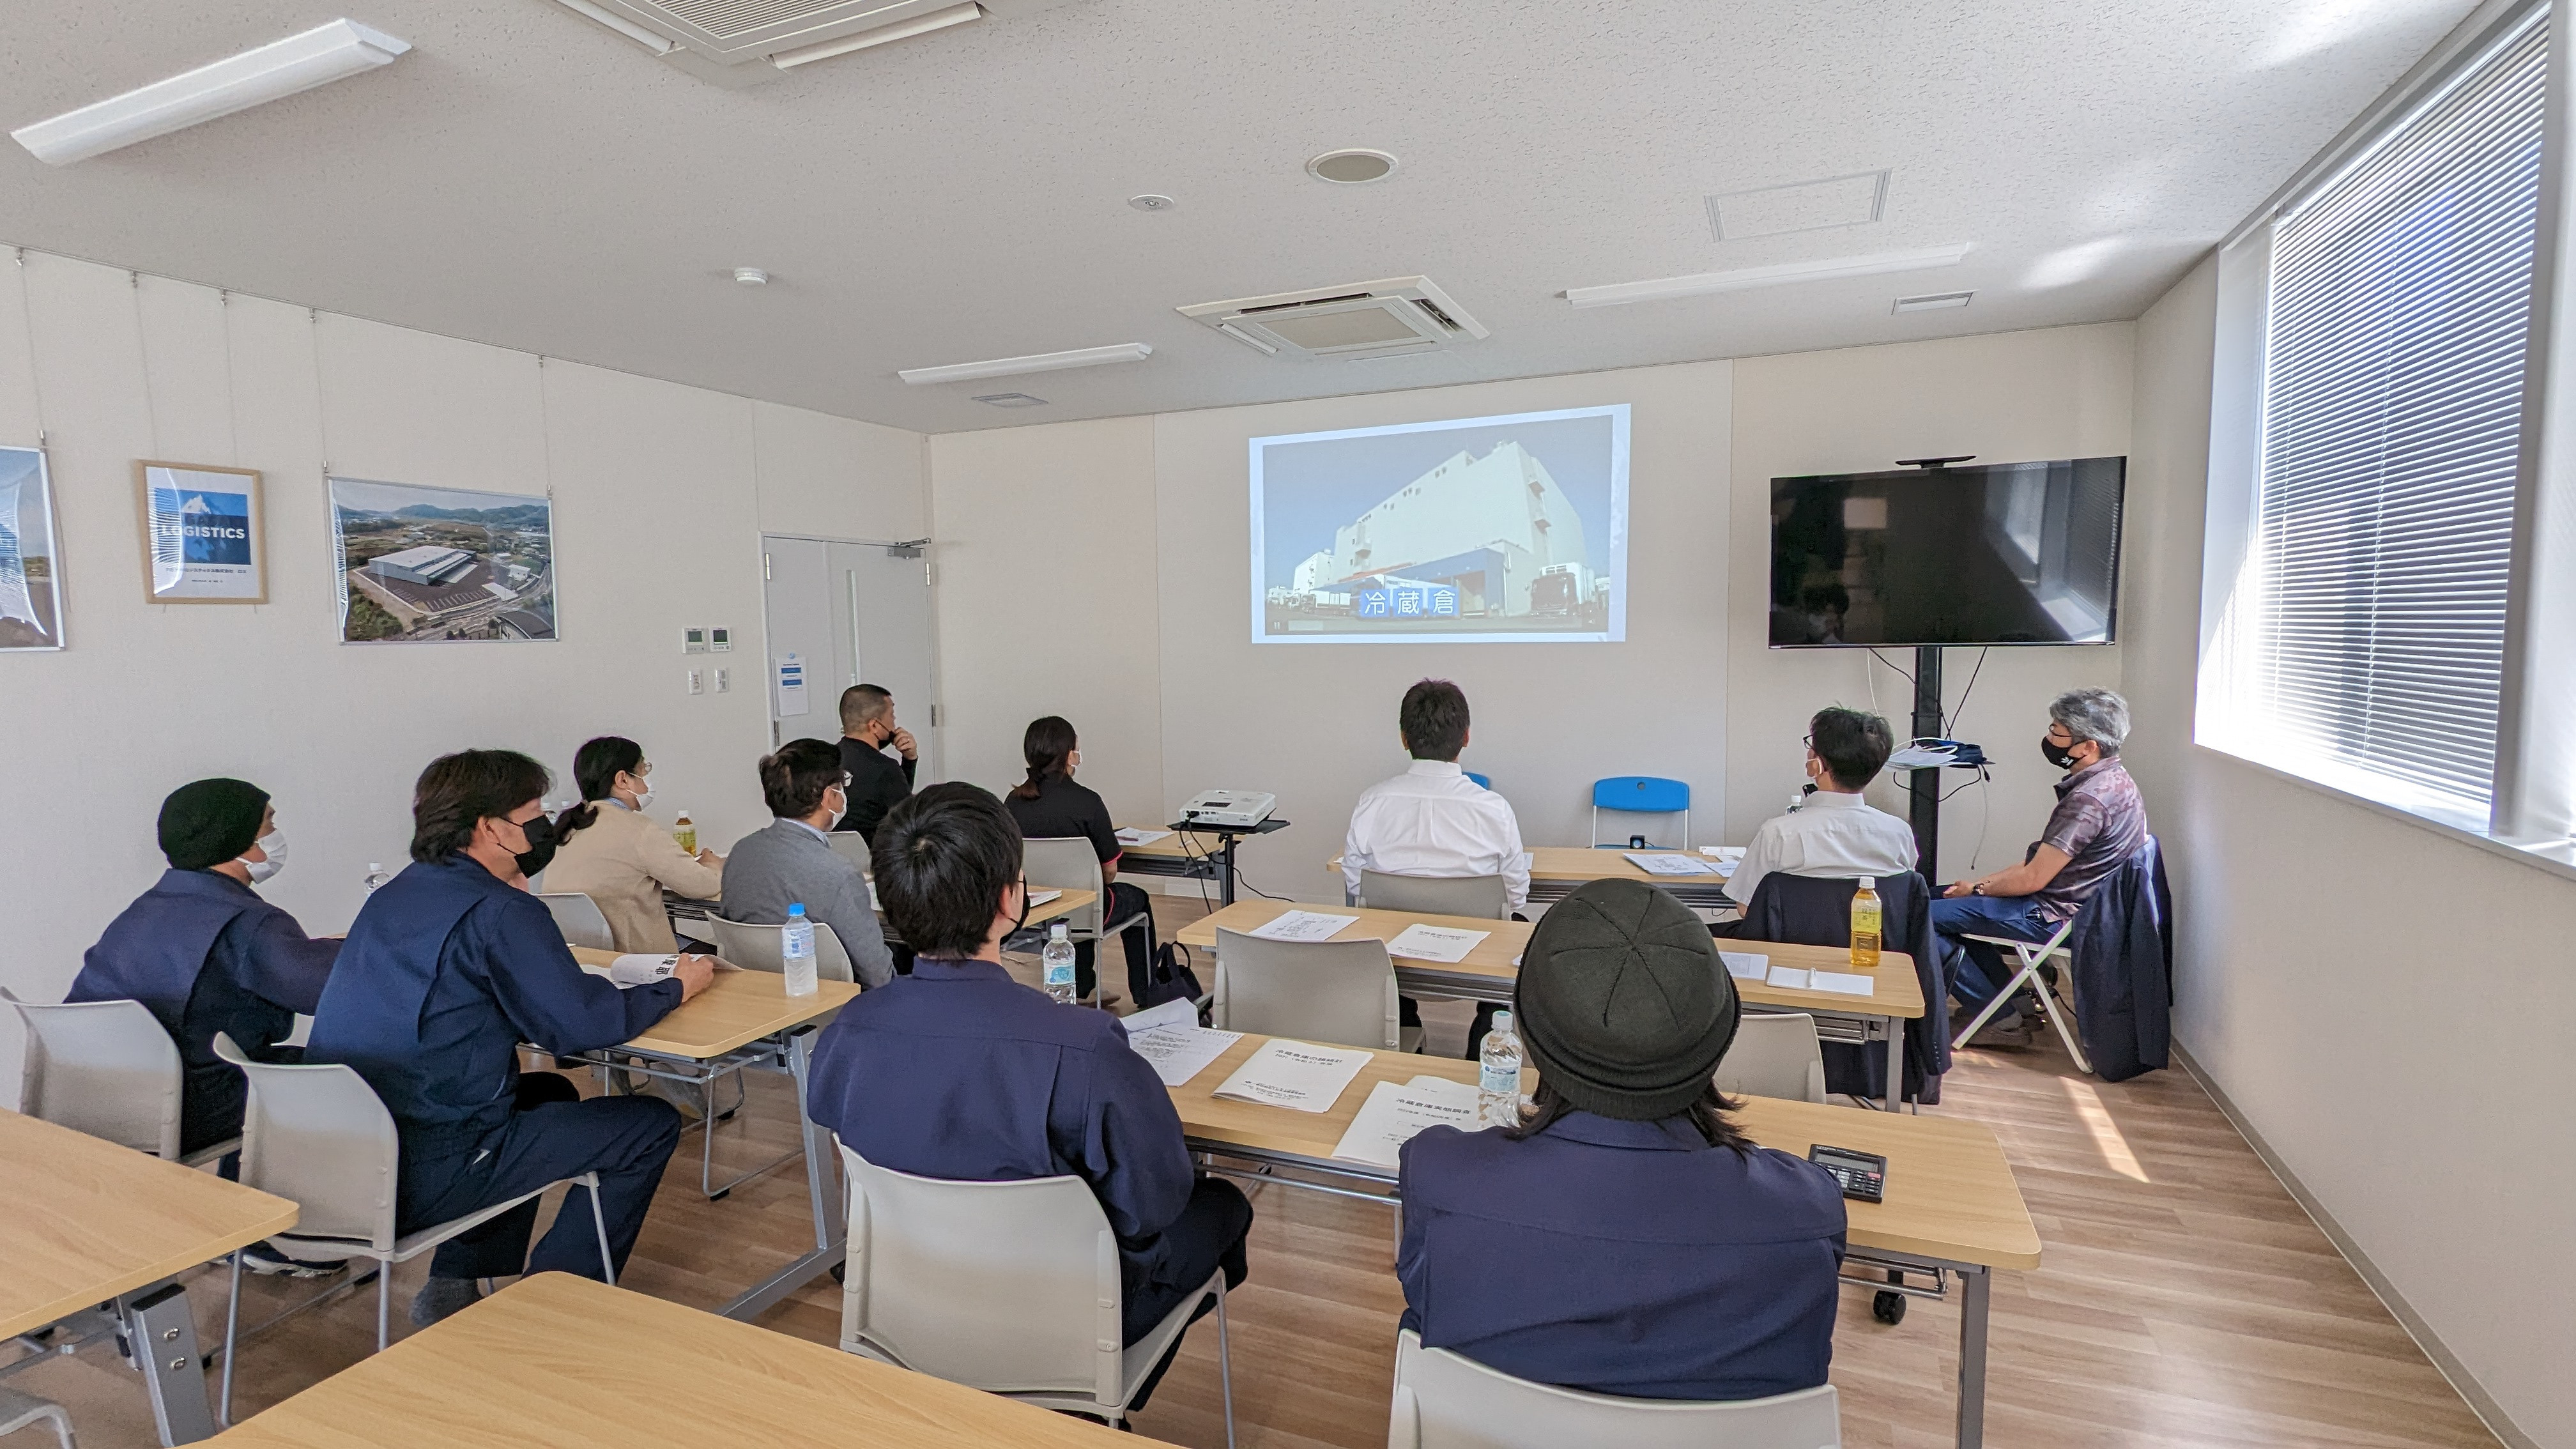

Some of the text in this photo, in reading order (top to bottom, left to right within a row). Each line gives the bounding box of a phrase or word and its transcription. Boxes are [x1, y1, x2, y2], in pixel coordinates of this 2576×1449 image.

[162, 525, 245, 539] LOGISTICS
[1365, 589, 1455, 615] 冷蔵倉
[1396, 1098, 1471, 1114] 冷蔵倉庫実態調査
